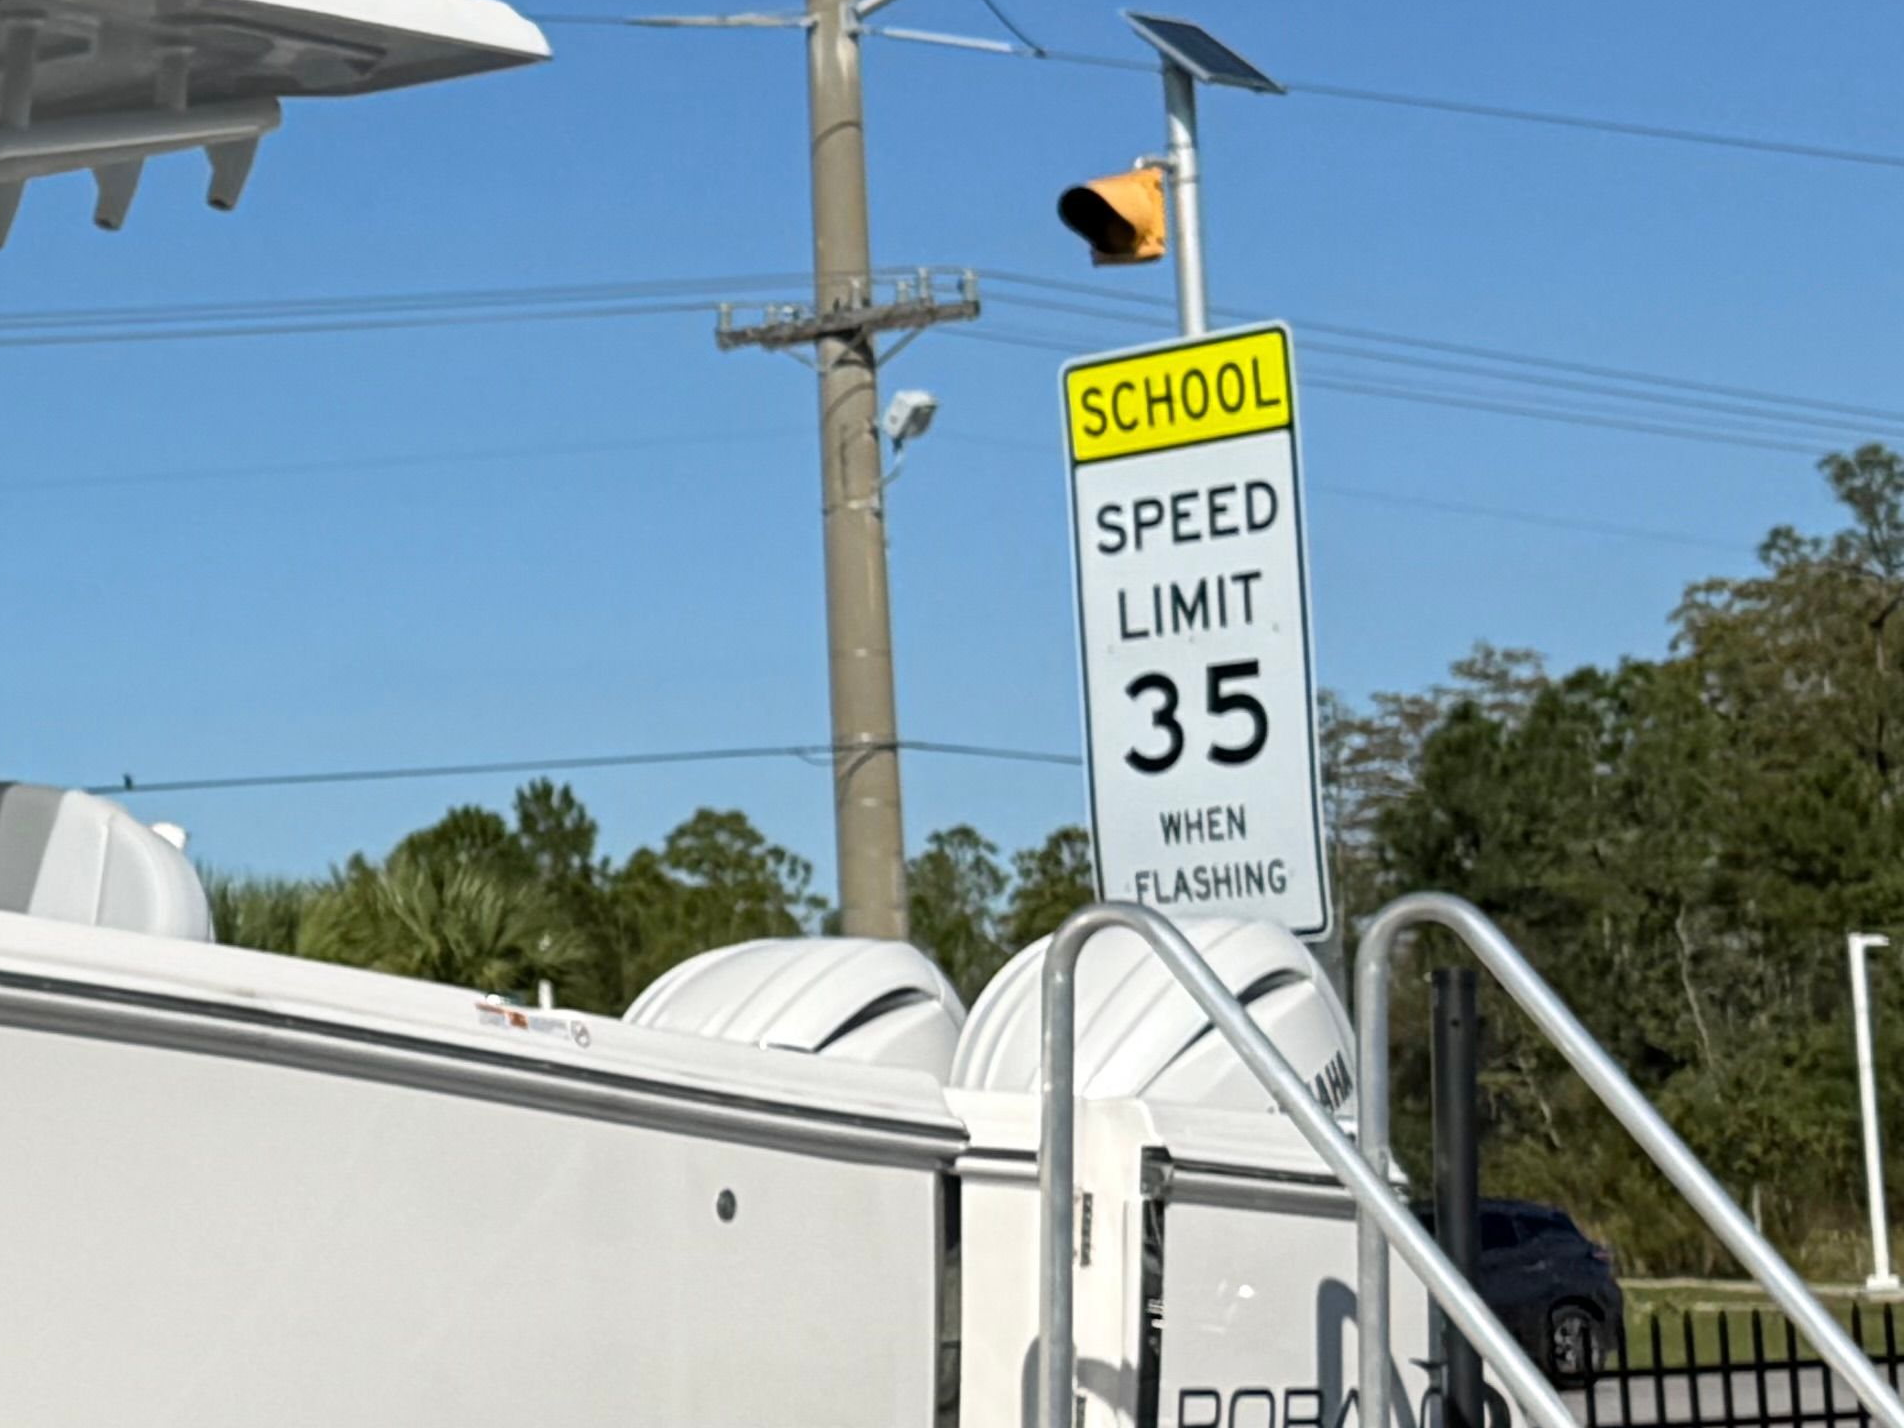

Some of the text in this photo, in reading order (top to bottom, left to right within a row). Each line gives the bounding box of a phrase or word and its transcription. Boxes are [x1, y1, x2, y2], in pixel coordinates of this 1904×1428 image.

[1080, 357, 1281, 437] SCHOOL
[1096, 480, 1279, 555] SPEED
[1118, 570, 1263, 641] LIMIT
[1124, 659, 1269, 773] 35
[1160, 804, 1248, 845] WHEN
[1134, 858, 1288, 905] FLASHING
